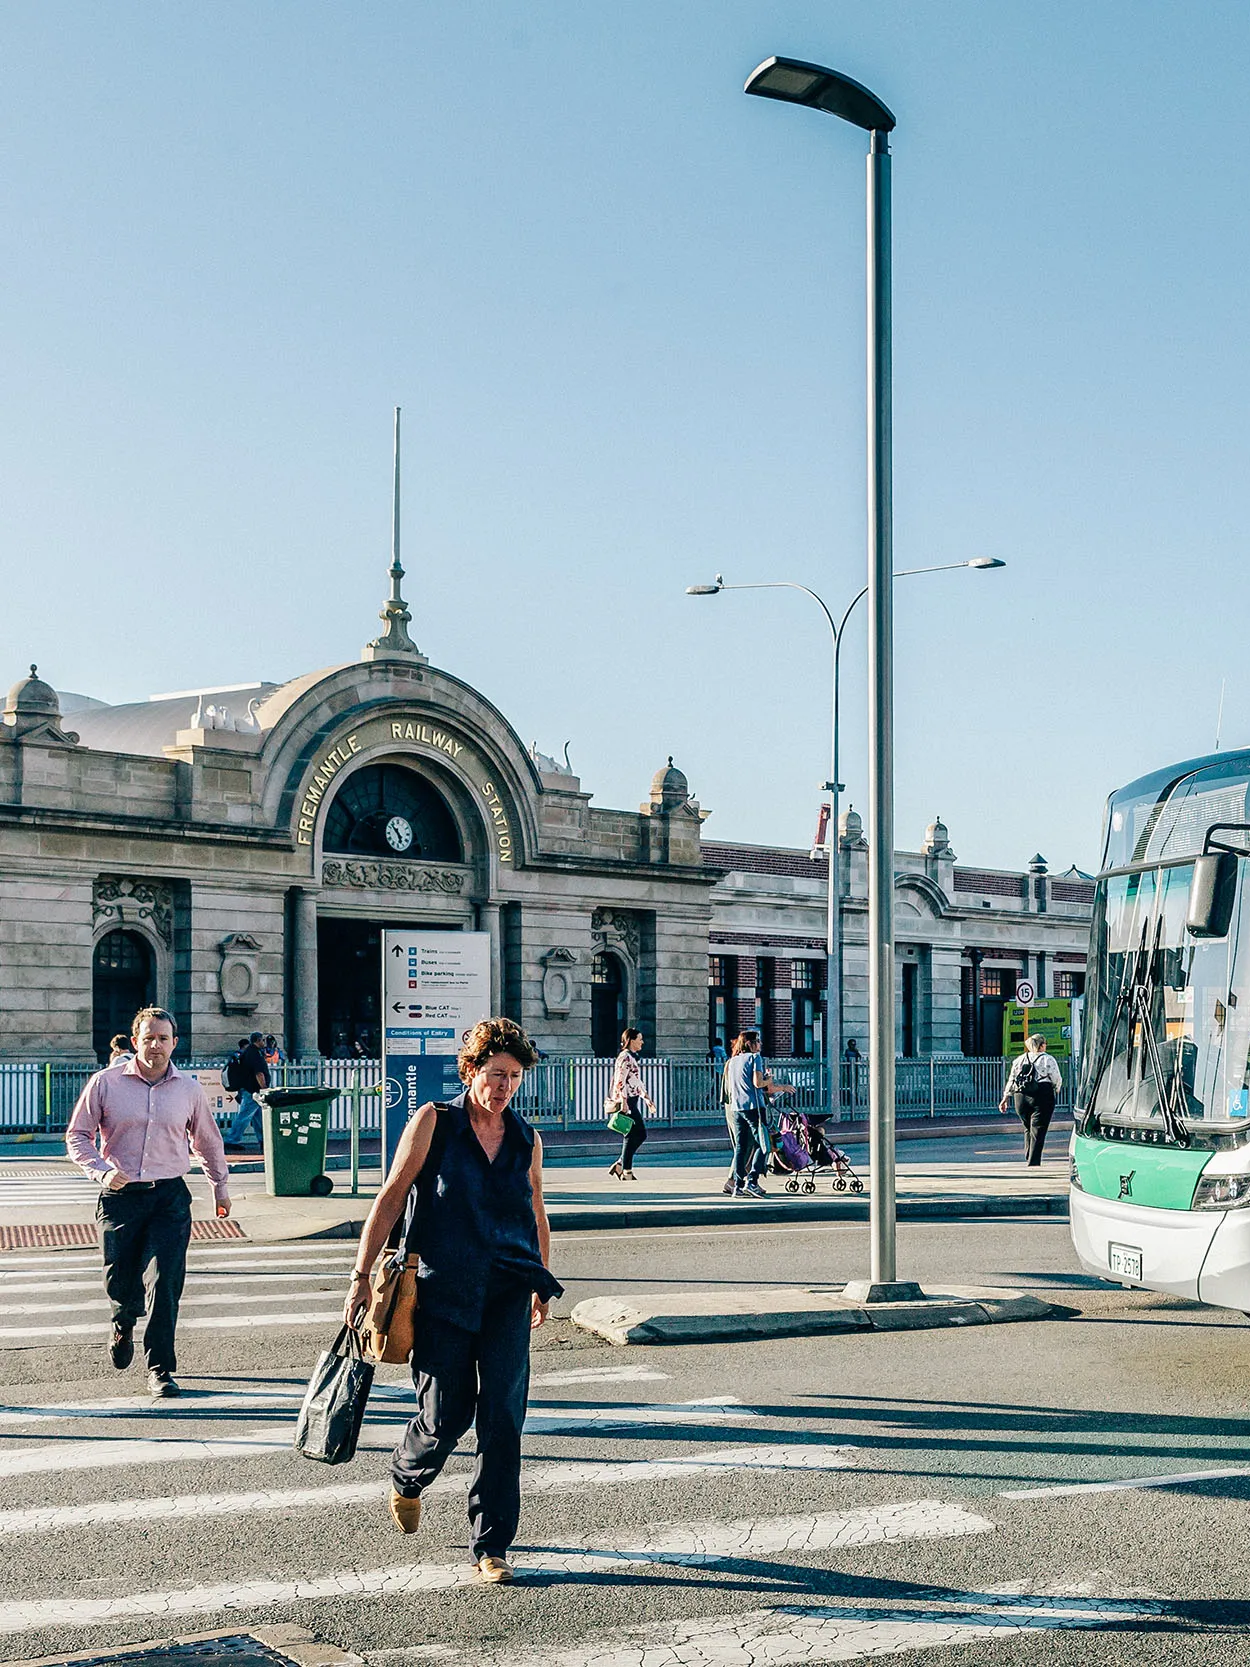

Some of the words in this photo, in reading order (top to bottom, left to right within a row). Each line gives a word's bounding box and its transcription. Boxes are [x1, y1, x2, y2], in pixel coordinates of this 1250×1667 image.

[298, 735, 362, 846] FREMANTLE
[391, 723, 463, 758] RAILWAY
[481, 782, 512, 862] STATION
[1020, 988, 1030, 998] 15
[431, 1029, 448, 1037] Entry
